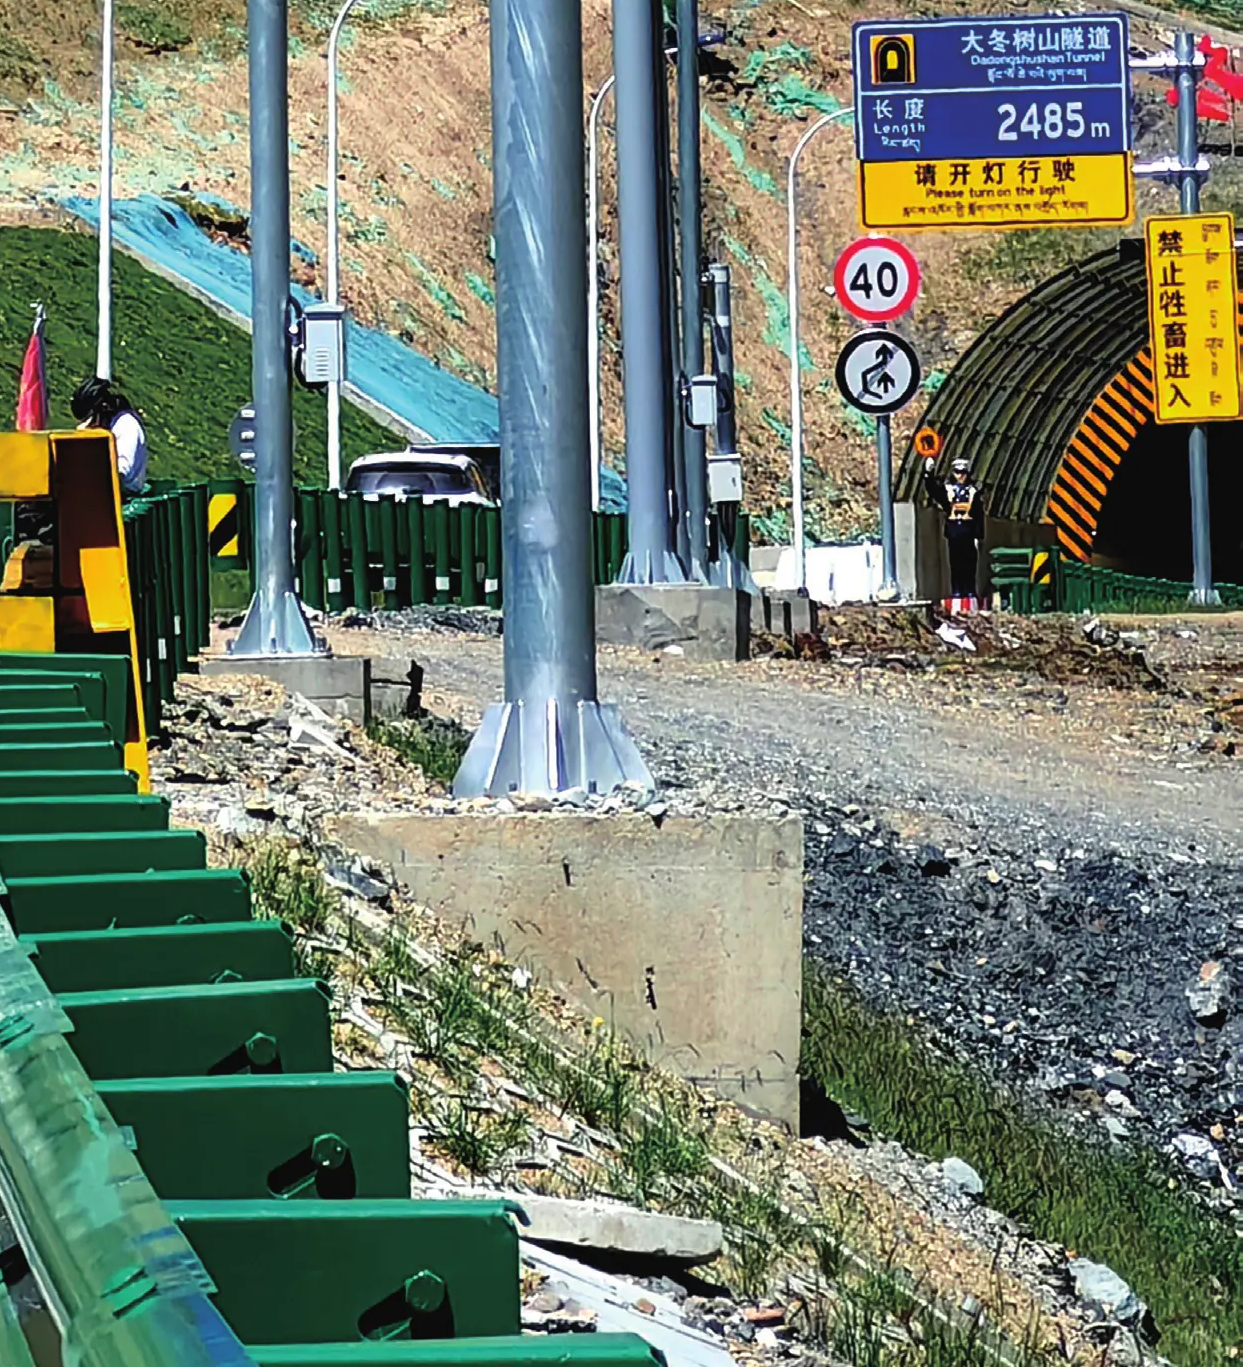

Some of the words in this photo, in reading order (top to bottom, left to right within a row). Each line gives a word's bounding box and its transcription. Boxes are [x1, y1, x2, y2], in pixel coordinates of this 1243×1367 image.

[961, 25, 1111, 54] 大冬树山隧道
[872, 97, 924, 120] 长度
[873, 122, 925, 137] Length
[914, 158, 1076, 186] 请开灯行驶
[925, 187, 964, 199] Please
[1015, 184, 1035, 196] the
[1039, 183, 1066, 201] light
[848, 261, 899, 300] 40
[1157, 229, 1192, 409] 禁止牲畜进入
